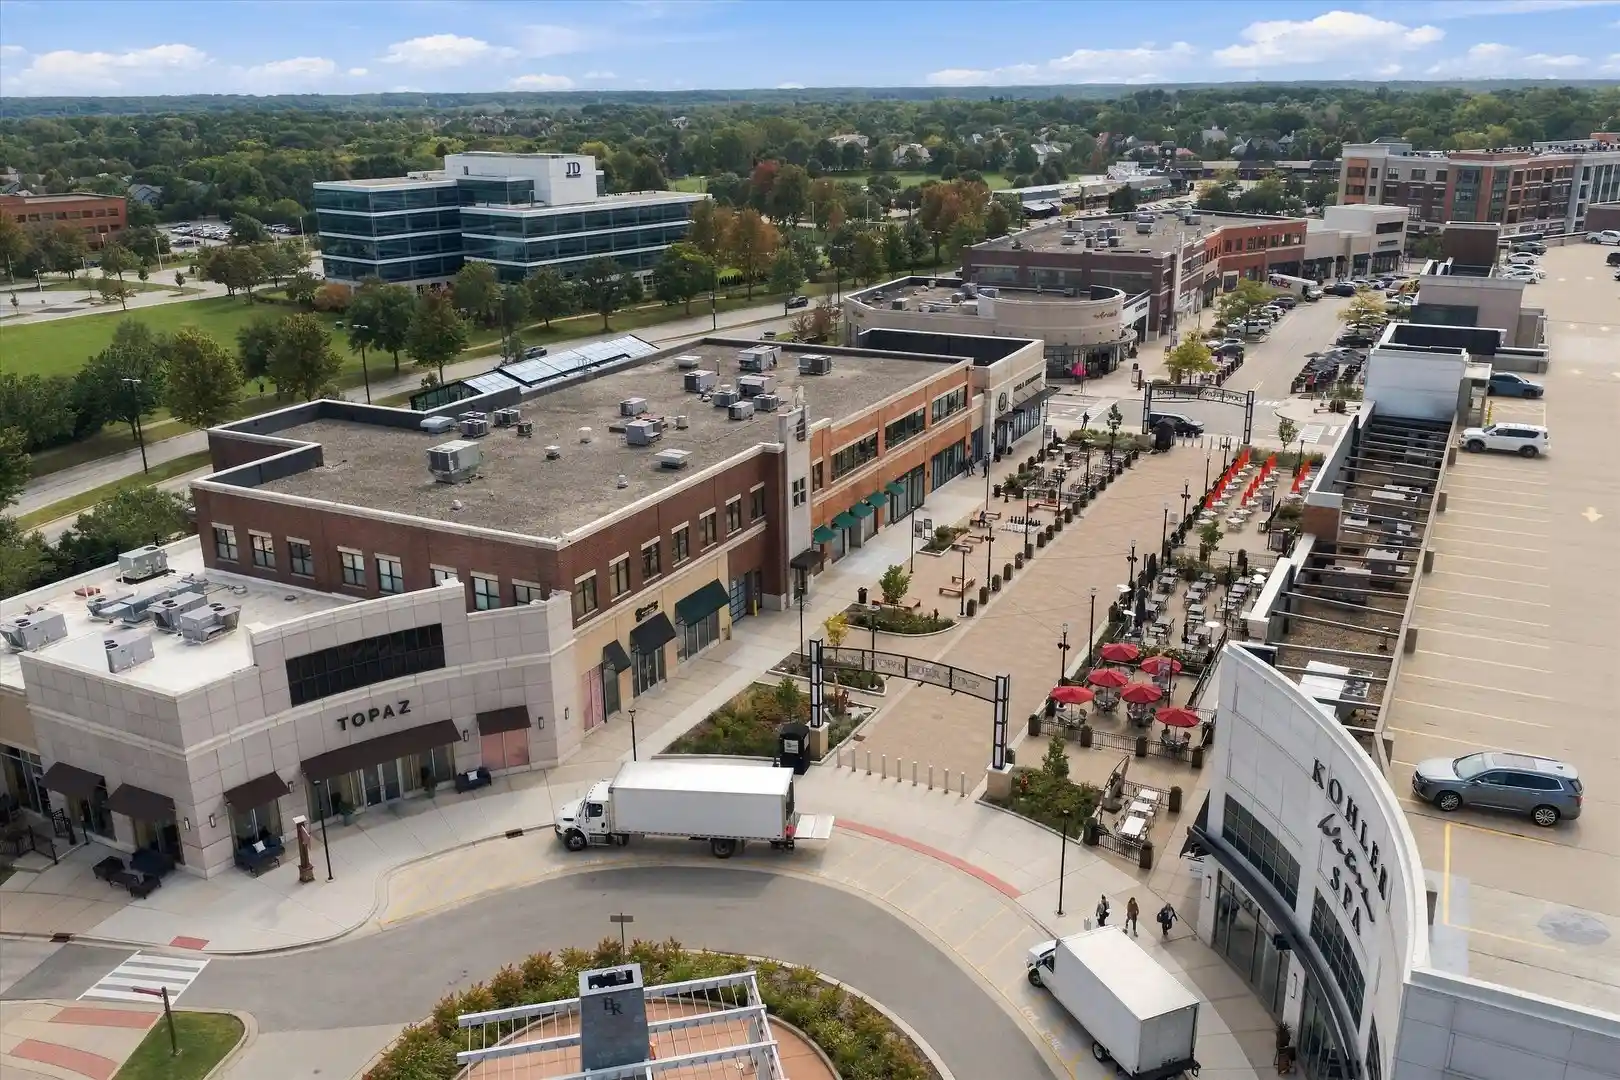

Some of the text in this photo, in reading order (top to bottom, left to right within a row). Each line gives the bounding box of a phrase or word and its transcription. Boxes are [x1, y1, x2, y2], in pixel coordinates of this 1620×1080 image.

[565, 161, 581, 174] JD
[336, 699, 411, 731] TOPAZ
[1311, 756, 1388, 901] KOHLER
[1330, 866, 1361, 936] SPA
